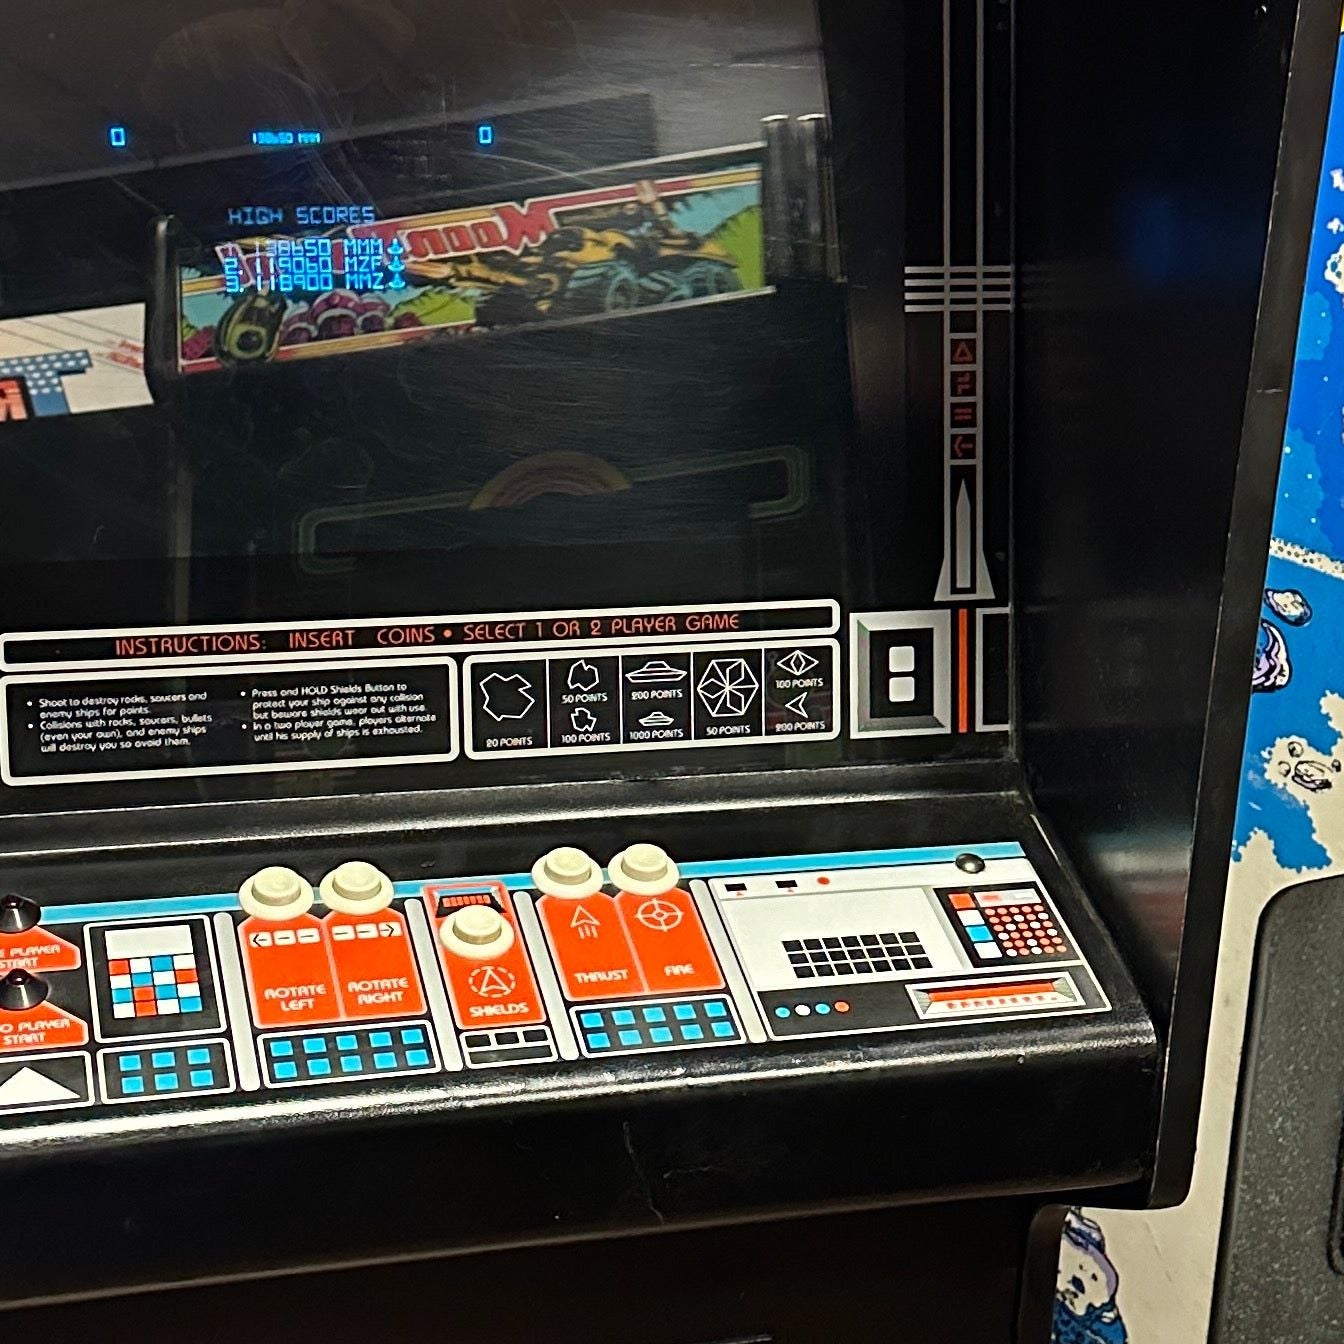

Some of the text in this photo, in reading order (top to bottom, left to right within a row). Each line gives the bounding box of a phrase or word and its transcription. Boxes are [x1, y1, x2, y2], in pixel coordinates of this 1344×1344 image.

[227, 206, 375, 226] HIGH SCORES
[344, 238, 384, 256] MMM
[345, 272, 384, 290] MMZ
[463, 613, 740, 640] SELECT 1 OR 2 PLAYER GAME
[115, 626, 435, 655] INSTRUCTIONS: INSERT COINS
[776, 678, 823, 688] 100 POINTS
[252, 683, 407, 698] Press and HOLD Shields Button to
[561, 692, 607, 703] 50 POINTS
[631, 689, 683, 700] 200 POINTS
[39, 698, 67, 708] Shoot
[69, 698, 80, 707] to
[82, 696, 119, 707] destroy
[188, 692, 207, 701] and
[253, 700, 286, 710] protect
[289, 700, 308, 708] your
[311, 697, 330, 708] ship
[333, 696, 367, 706] against
[370, 695, 387, 704] any
[40, 711, 72, 720] enemy
[75, 708, 100, 719] ships
[103, 707, 116, 716] for
[253, 710, 268, 720] but
[272, 709, 307, 719] beware
[310, 707, 342, 717] shields
[344, 706, 367, 715] wear
[371, 705, 385, 713] out
[388, 704, 407, 713] with
[86, 719, 106, 728] with
[274, 721, 292, 729] two
[295, 719, 324, 730] player
[359, 716, 392, 726] players
[395, 714, 436, 723] alternate
[776, 721, 825, 732] 200 POINTS
[71, 732, 92, 742] your
[126, 728, 145, 737] and
[148, 727, 180, 737] enemy
[183, 725, 206, 736] ships
[254, 732, 273, 741] until
[276, 730, 288, 740] his
[291, 729, 321, 740] supply
[336, 727, 360, 738] ships
[561, 732, 610, 743] 100 POINTS
[629, 729, 683, 740] 1000 POINTS
[706, 725, 750, 736] 50 POINTS
[59, 741, 96, 752] destroy
[99, 741, 117, 750] you
[120, 740, 131, 749] so
[135, 738, 162, 748] avoid
[486, 737, 532, 748] 20 POINTS
[10, 944, 61, 957] PLAYER
[574, 969, 628, 984] THRUST
[664, 964, 695, 976] FIRE
[347, 977, 409, 992] ROTATE
[264, 984, 327, 1000] ROTATE
[358, 991, 403, 1005] RIGHT
[281, 998, 315, 1011] LEFT
[469, 1002, 530, 1017] SHIELDS
[18, 1018, 71, 1031] PLAYER
[3, 1032, 45, 1045] START
